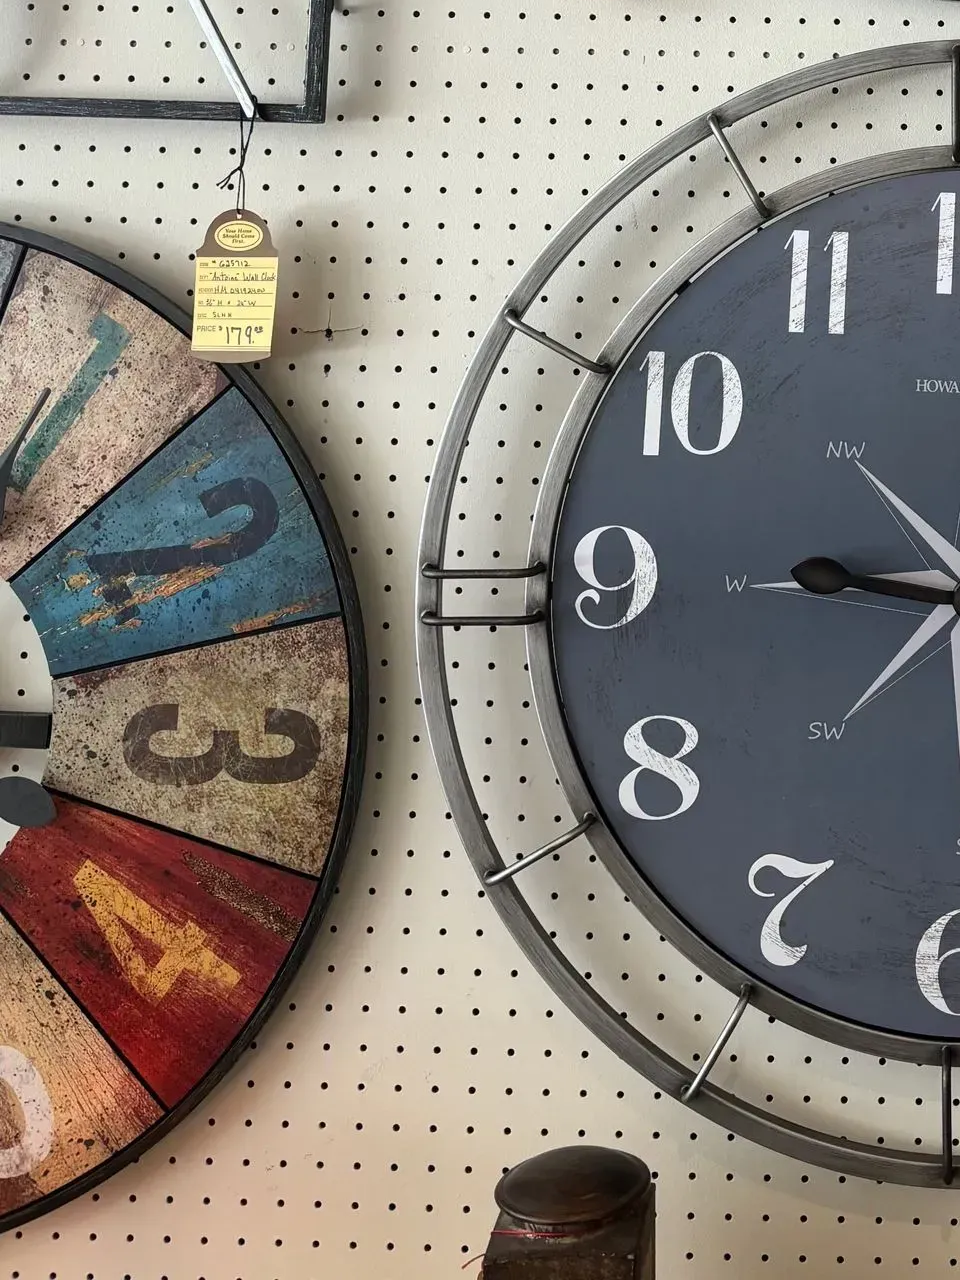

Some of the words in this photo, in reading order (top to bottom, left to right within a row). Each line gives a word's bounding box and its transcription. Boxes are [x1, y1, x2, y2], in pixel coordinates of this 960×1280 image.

[783, 229, 849, 335] 11
[639, 349, 744, 456] 10
[826, 440, 866, 460] NW
[85, 477, 280, 622] 2
[573, 524, 658, 630] 9
[725, 574, 748, 593] W
[123, 703, 321, 786] 3
[618, 714, 700, 820] 8
[808, 721, 846, 741] SW
[73, 859, 242, 1000] 4
[748, 853, 835, 967] 7
